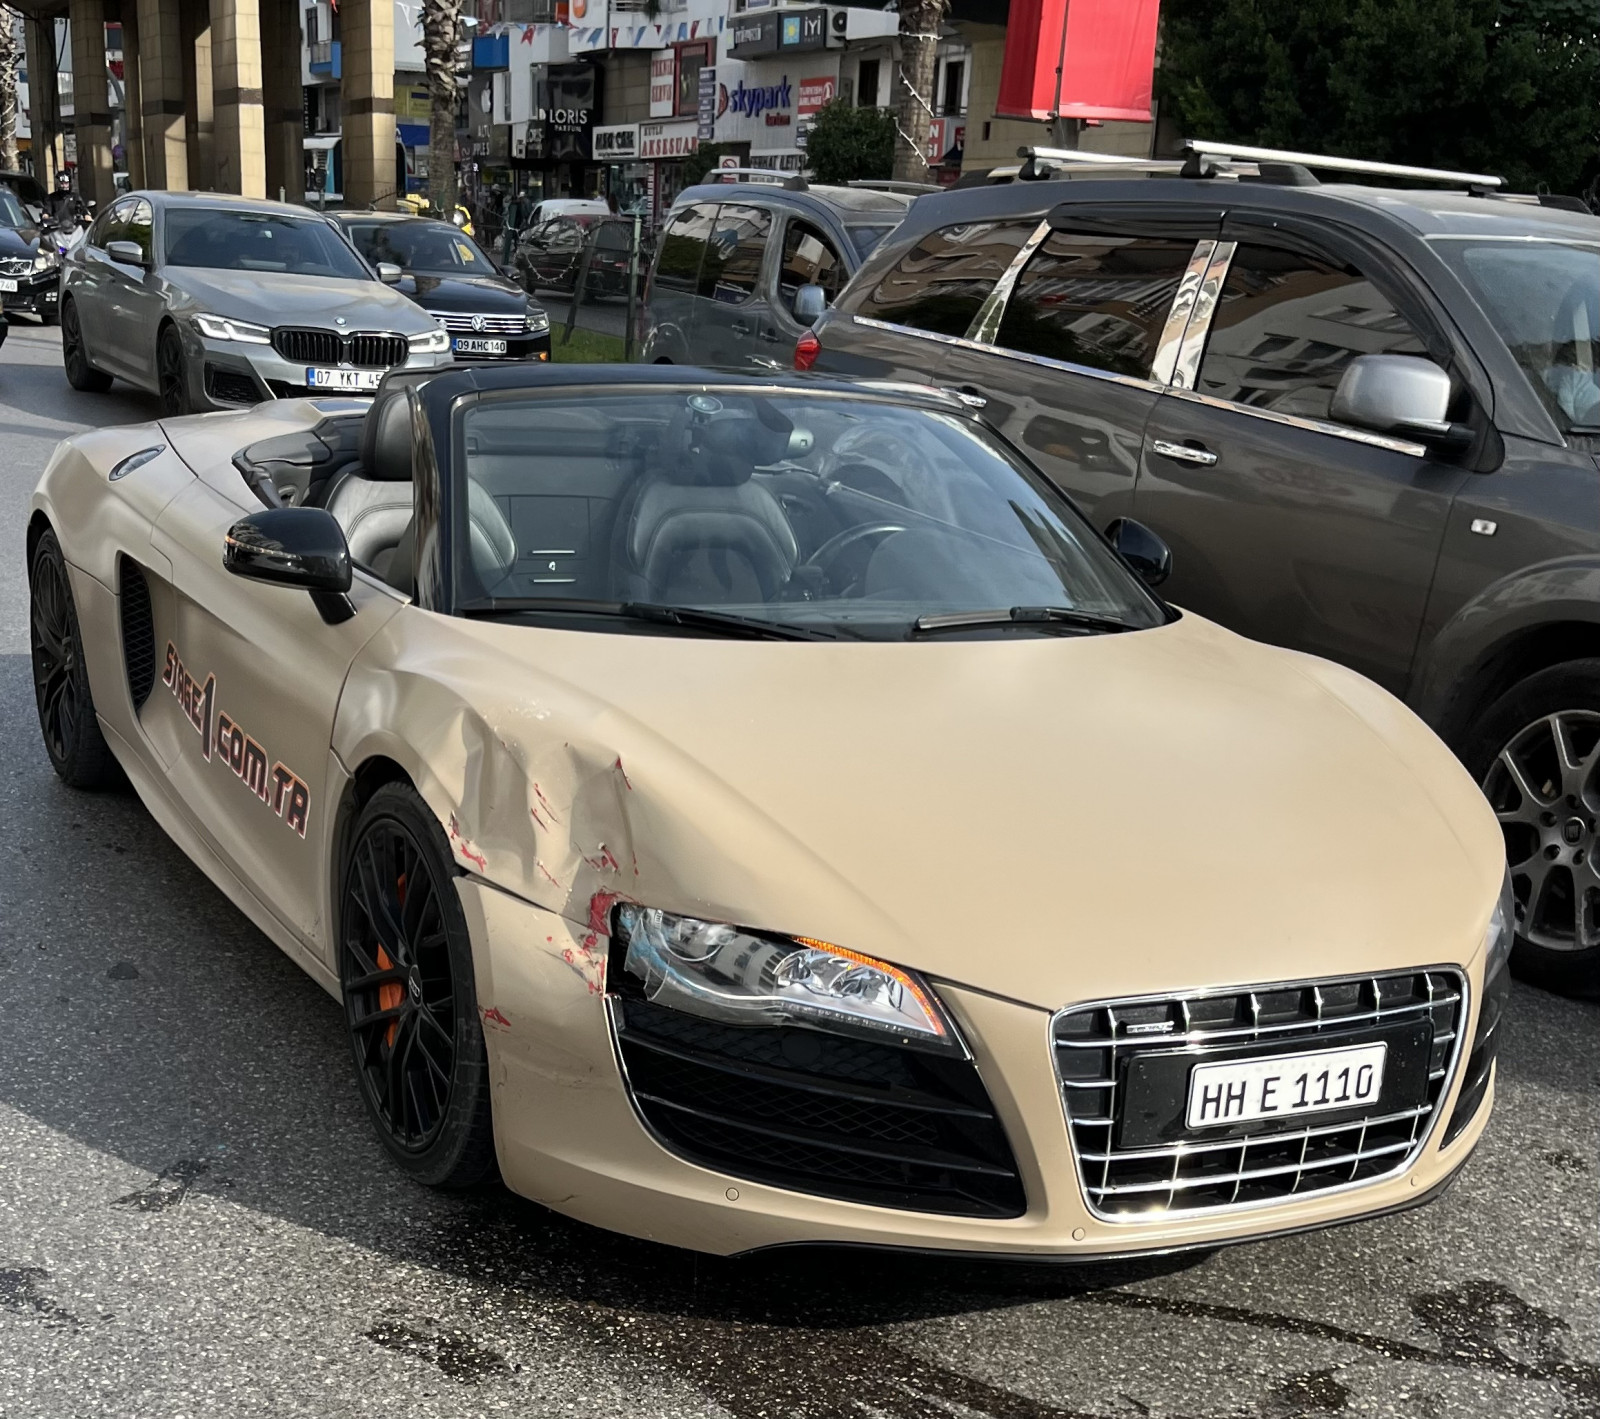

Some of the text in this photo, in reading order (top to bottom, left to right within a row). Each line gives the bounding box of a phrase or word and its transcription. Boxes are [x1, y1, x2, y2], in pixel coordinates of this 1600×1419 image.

[730, 75, 792, 118] skypark
[549, 108, 588, 124] LORIS
[641, 136, 698, 156] AKSESUAR
[457, 340, 506, 352] 09 AHC 140
[317, 370, 331, 385] 07
[340, 372, 360, 386] YKT
[1200, 1063, 1374, 1120] HH E 1110
